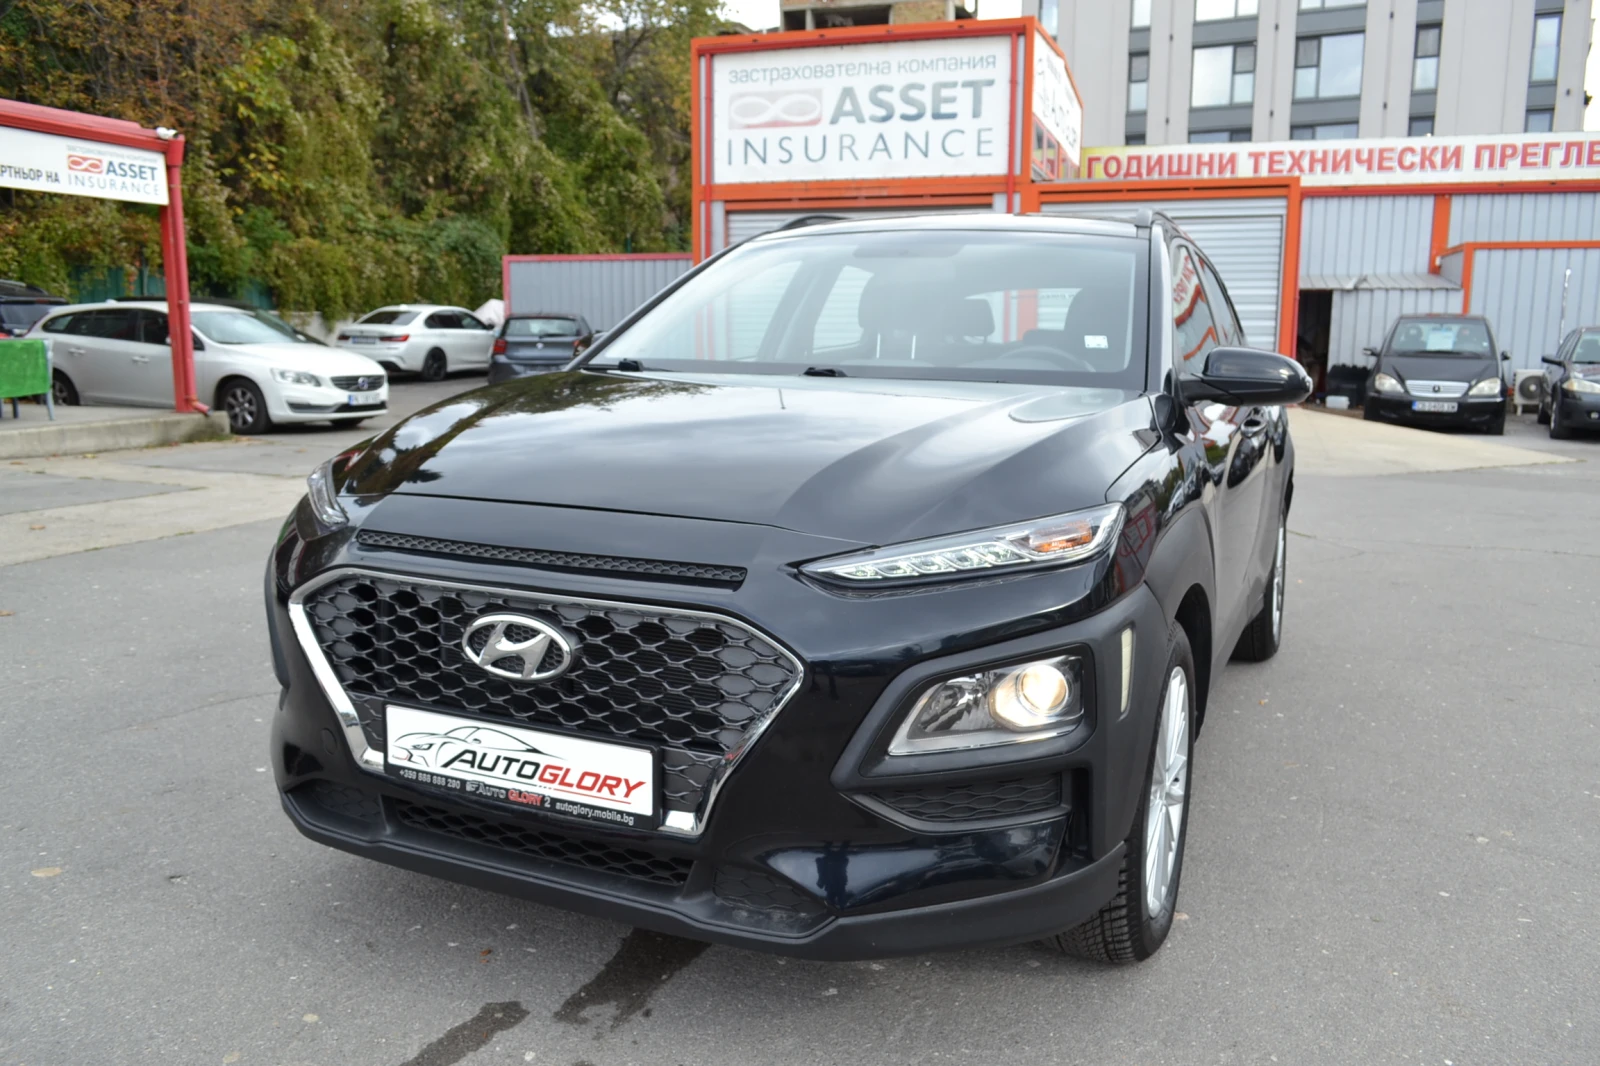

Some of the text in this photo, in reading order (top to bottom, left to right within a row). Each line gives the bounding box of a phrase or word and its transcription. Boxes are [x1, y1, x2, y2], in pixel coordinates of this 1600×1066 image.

[728, 53, 997, 86] застрахователна компания
[829, 78, 996, 125] ASSET
[727, 127, 994, 166] INSURANCE
[0, 163, 61, 184] РТНЬОР НА
[105, 160, 158, 181] ASSET
[1086, 152, 1238, 179] ГОДИШНИ
[1247, 145, 1464, 175] ТЕХНИЧЕСКИ
[67, 173, 160, 196] INSURANCE
[440, 748, 646, 799] AUTOGLORY
[507, 788, 543, 806] GLORY
[544, 795, 551, 808] 2
[555, 801, 634, 826] autoglory.mobile.bg
